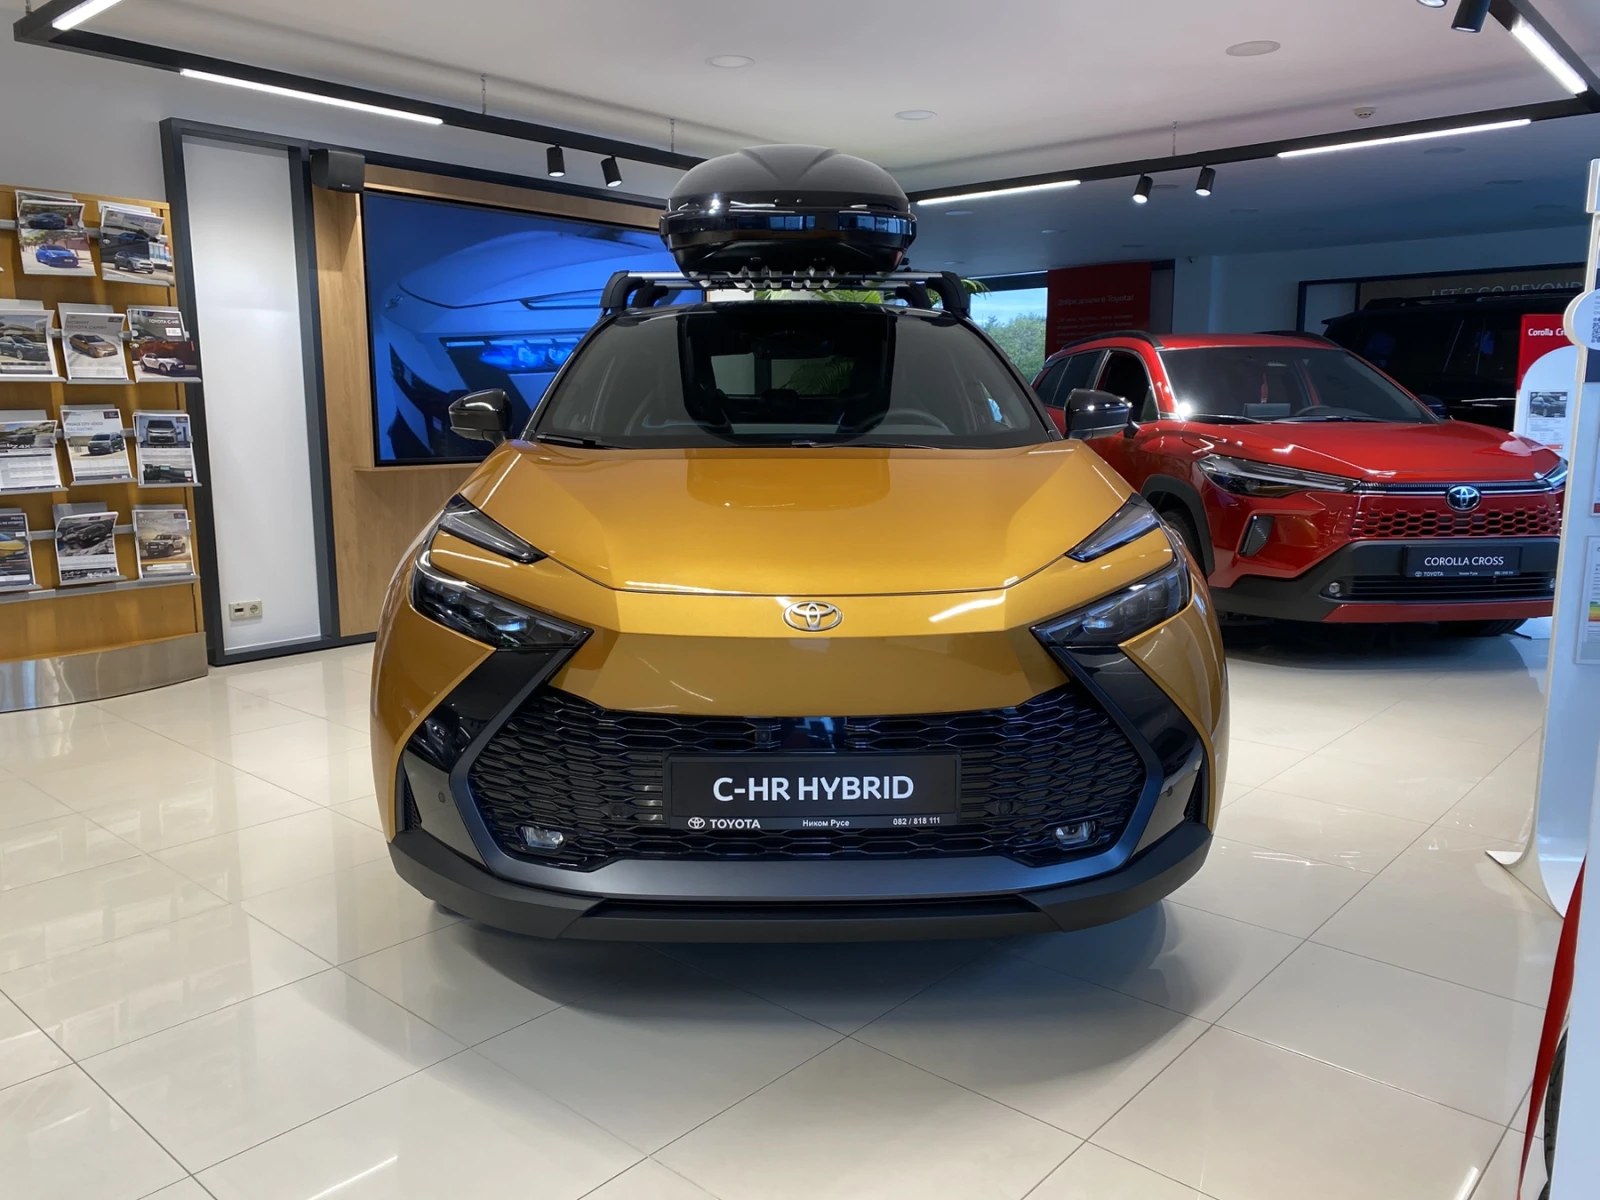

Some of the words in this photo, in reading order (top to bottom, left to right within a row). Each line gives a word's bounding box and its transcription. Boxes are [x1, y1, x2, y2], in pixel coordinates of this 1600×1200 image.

[1107, 294, 1134, 303] Toyota!
[1528, 328, 1554, 336] Corolla
[1424, 557, 1470, 566] COROLLA
[1471, 556, 1504, 566] CROSS
[713, 777, 791, 801] C-HR
[798, 775, 914, 801] HYBRID
[709, 818, 761, 829] TOYOTA
[802, 819, 828, 828] Ником
[829, 819, 850, 828] Русе
[893, 817, 907, 826] 082
[913, 816, 928, 825] 818
[929, 816, 941, 825] 111
